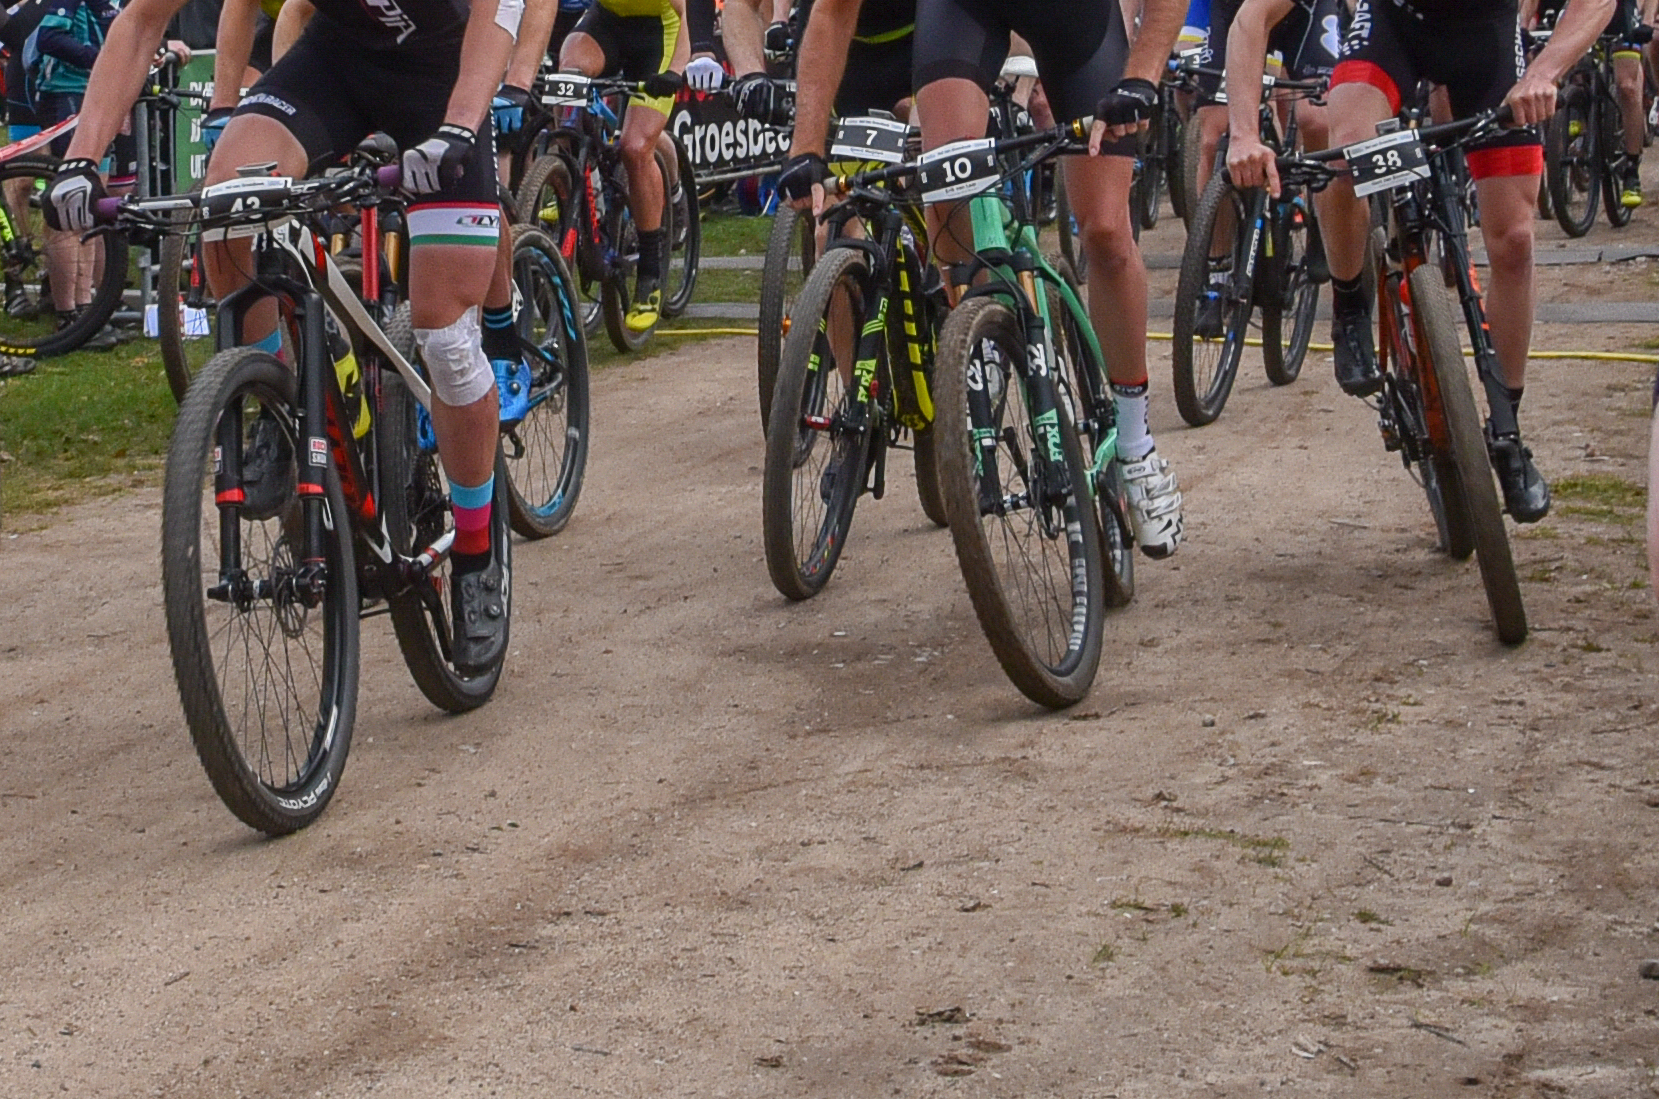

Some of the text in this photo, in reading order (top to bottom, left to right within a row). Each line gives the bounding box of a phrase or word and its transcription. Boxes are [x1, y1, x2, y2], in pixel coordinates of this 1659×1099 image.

[556, 82, 575, 96] 32
[866, 129, 878, 146] 7
[942, 157, 973, 183] 10
[1371, 149, 1402, 174] 38
